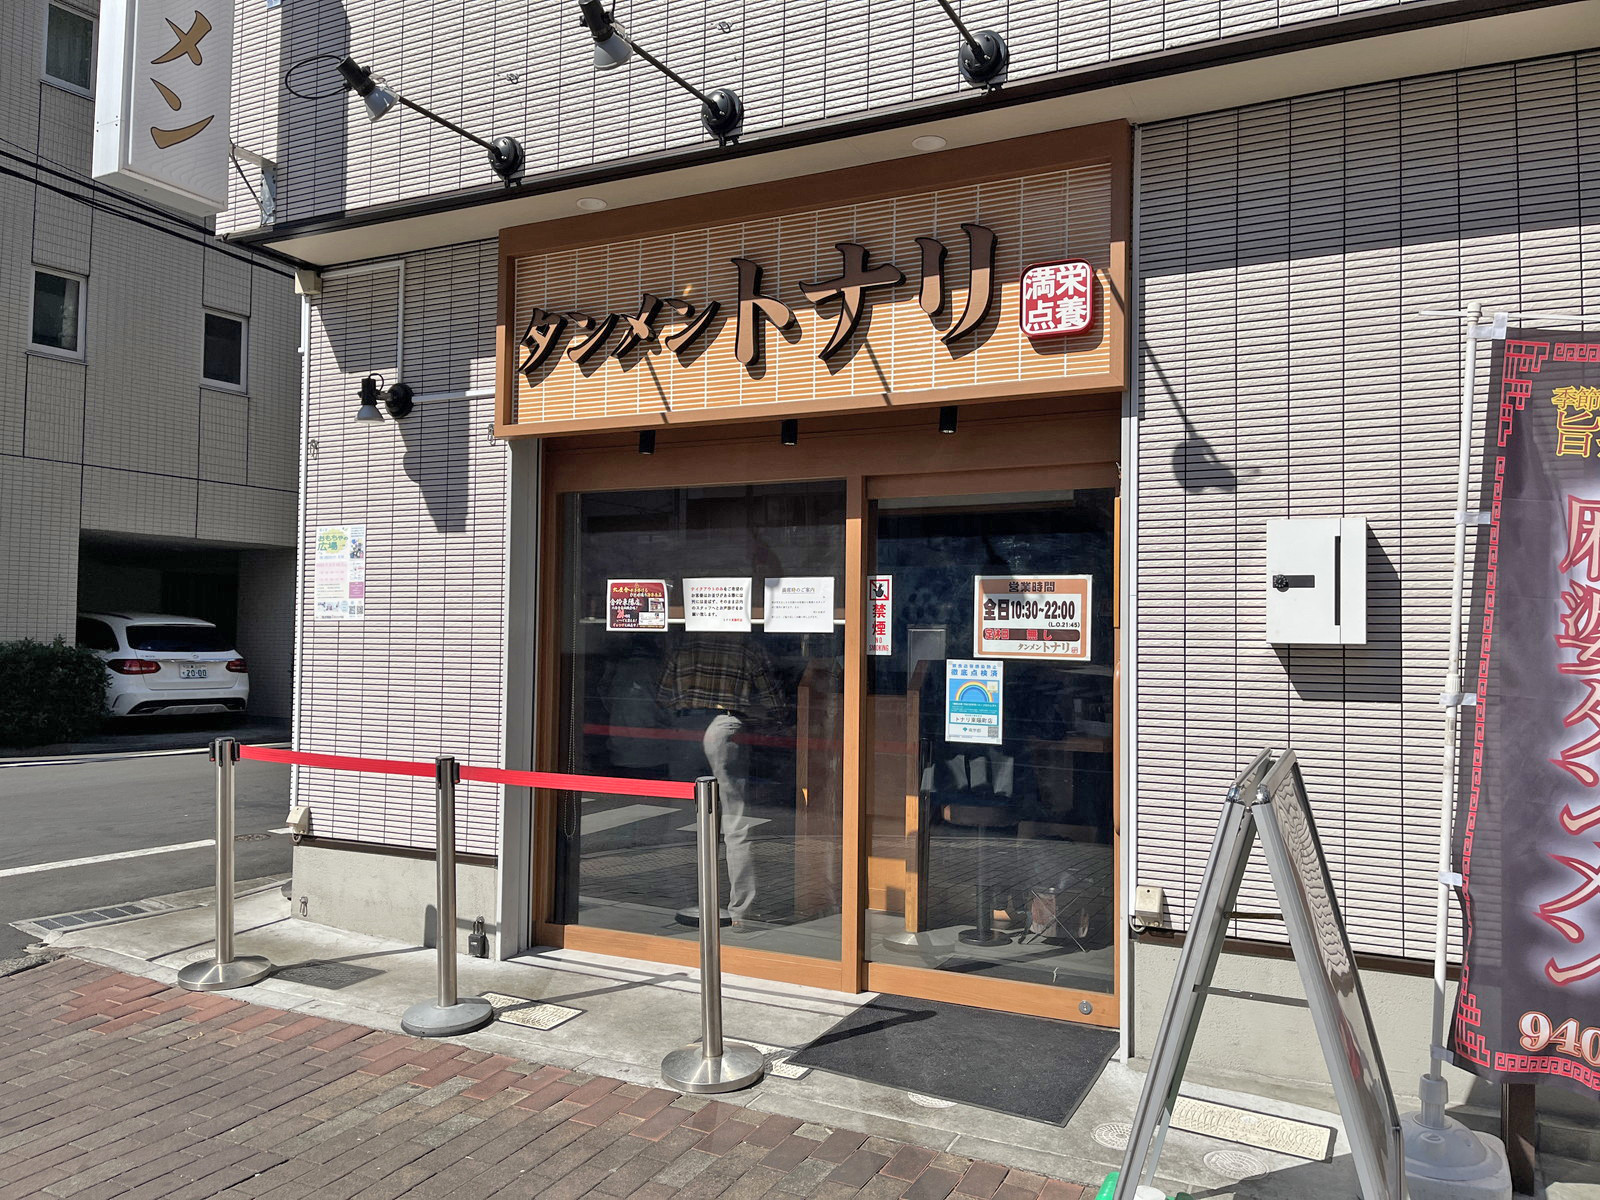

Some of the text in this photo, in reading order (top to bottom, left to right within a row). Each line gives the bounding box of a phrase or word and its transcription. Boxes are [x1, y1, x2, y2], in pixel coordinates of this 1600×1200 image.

[150, 10, 215, 149] メン
[1556, 409, 1600, 457] 旨
[1008, 582, 1056, 592] 営業時間
[872, 603, 886, 636] 禁煙
[984, 628, 1010, 640] 定休日
